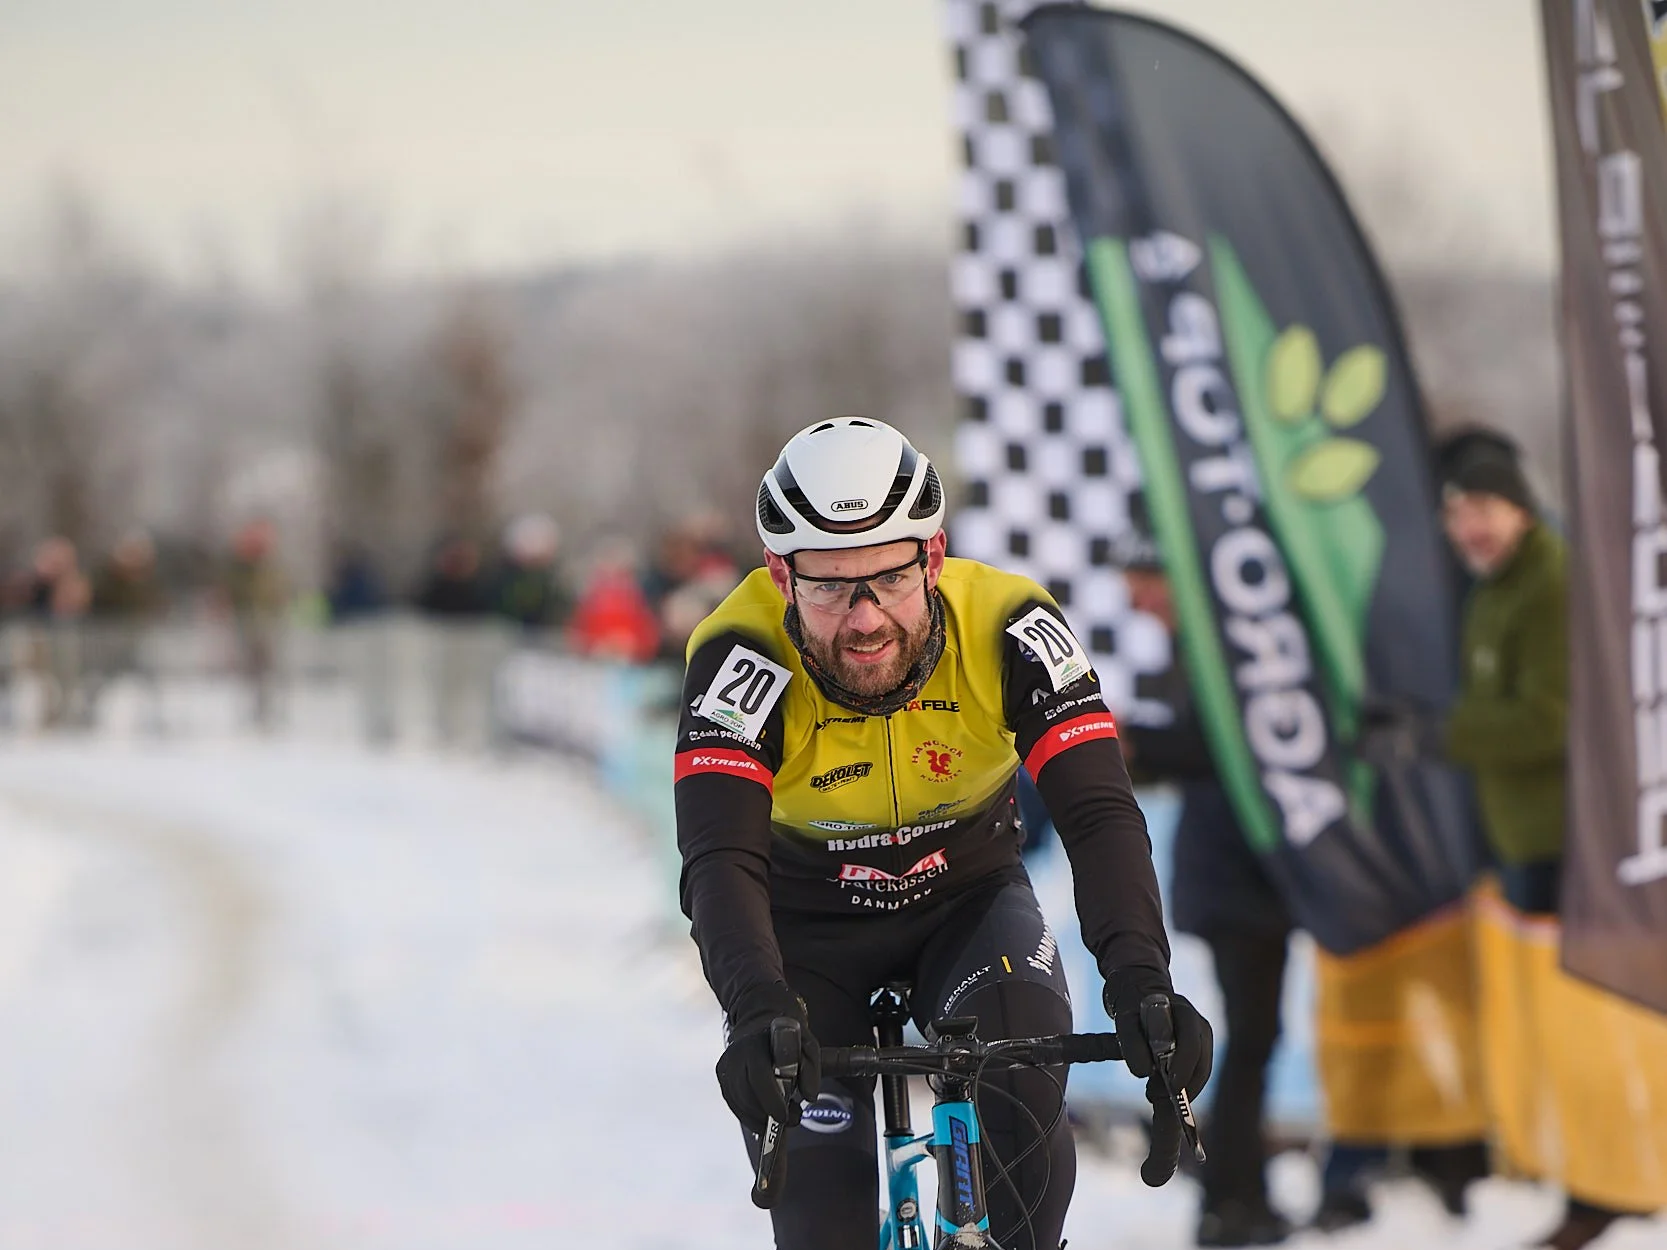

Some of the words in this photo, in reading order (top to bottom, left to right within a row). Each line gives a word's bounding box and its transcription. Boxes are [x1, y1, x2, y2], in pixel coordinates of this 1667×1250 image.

[836, 500, 864, 510] ABUS
[1023, 618, 1074, 667] 20
[717, 659, 776, 715] 20
[811, 763, 872, 788] DEKOLET
[944, 966, 991, 1011] RENAULT
[802, 1108, 851, 1120] VOLVO
